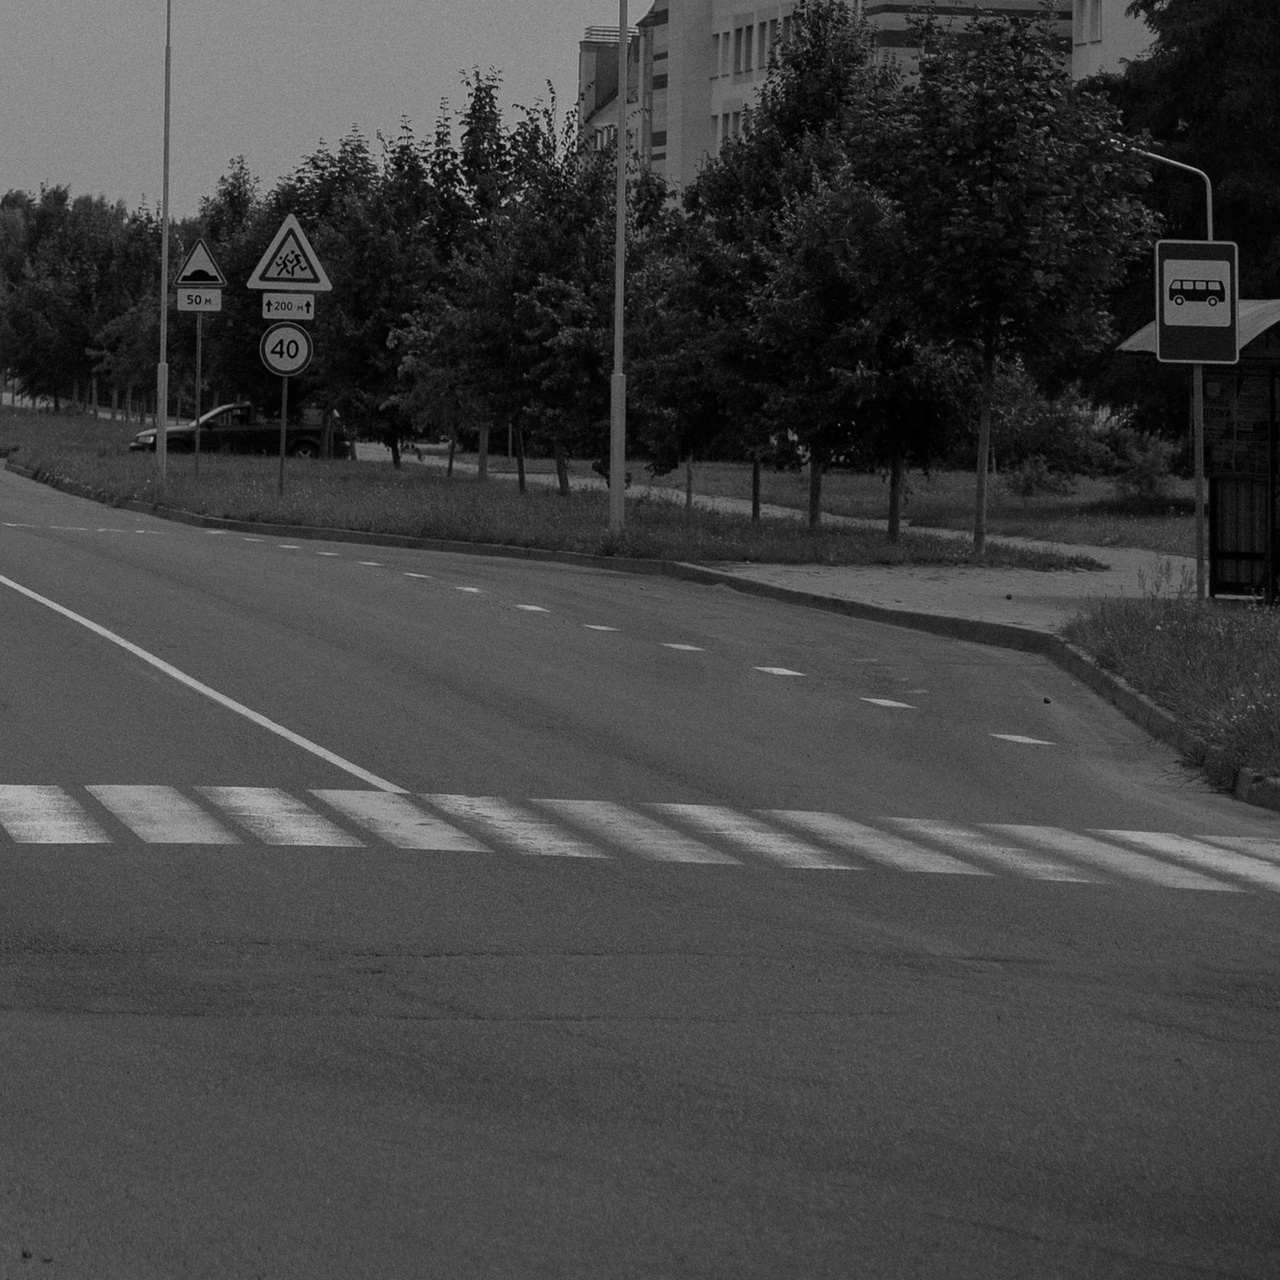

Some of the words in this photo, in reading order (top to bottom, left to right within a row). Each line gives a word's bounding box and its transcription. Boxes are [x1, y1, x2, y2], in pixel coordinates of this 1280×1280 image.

[186, 294, 202, 305] 50
[274, 301, 293, 311] 200
[270, 338, 299, 359] 40
